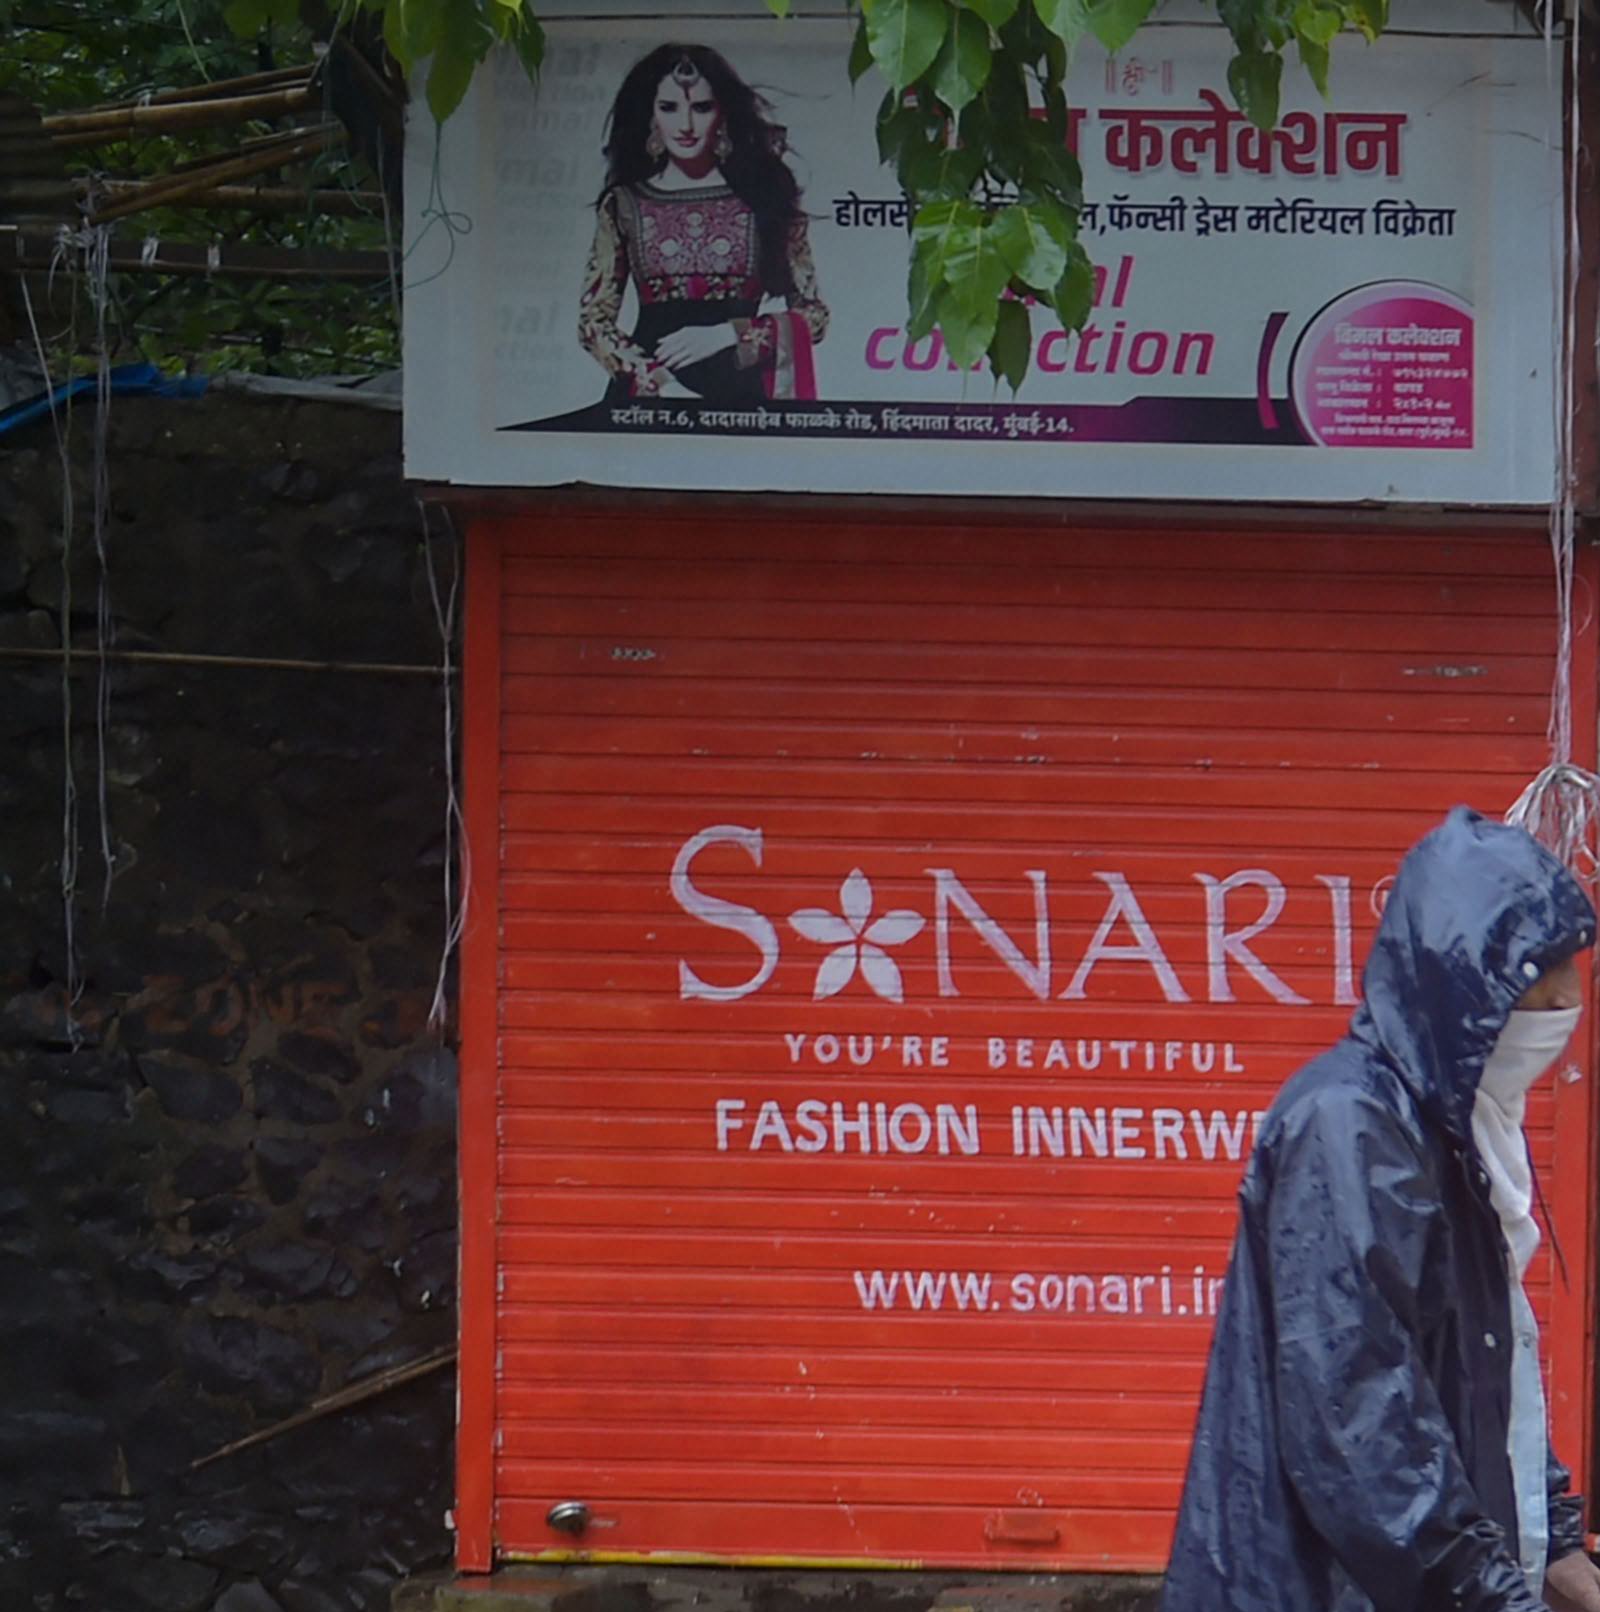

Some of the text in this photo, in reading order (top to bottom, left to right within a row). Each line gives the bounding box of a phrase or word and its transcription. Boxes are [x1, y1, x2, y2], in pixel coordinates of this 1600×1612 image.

[1193, 198, 1239, 237] ड्रेस
[1246, 197, 1367, 236] मटेरियल
[1373, 199, 1457, 238] विक्रेता
[864, 320, 1216, 375] coction
[610, 405, 654, 425] स्टॉल
[784, 1033, 1245, 1073] YOU'RE BEAUTIFUL
[715, 1098, 980, 1156] FASHION
